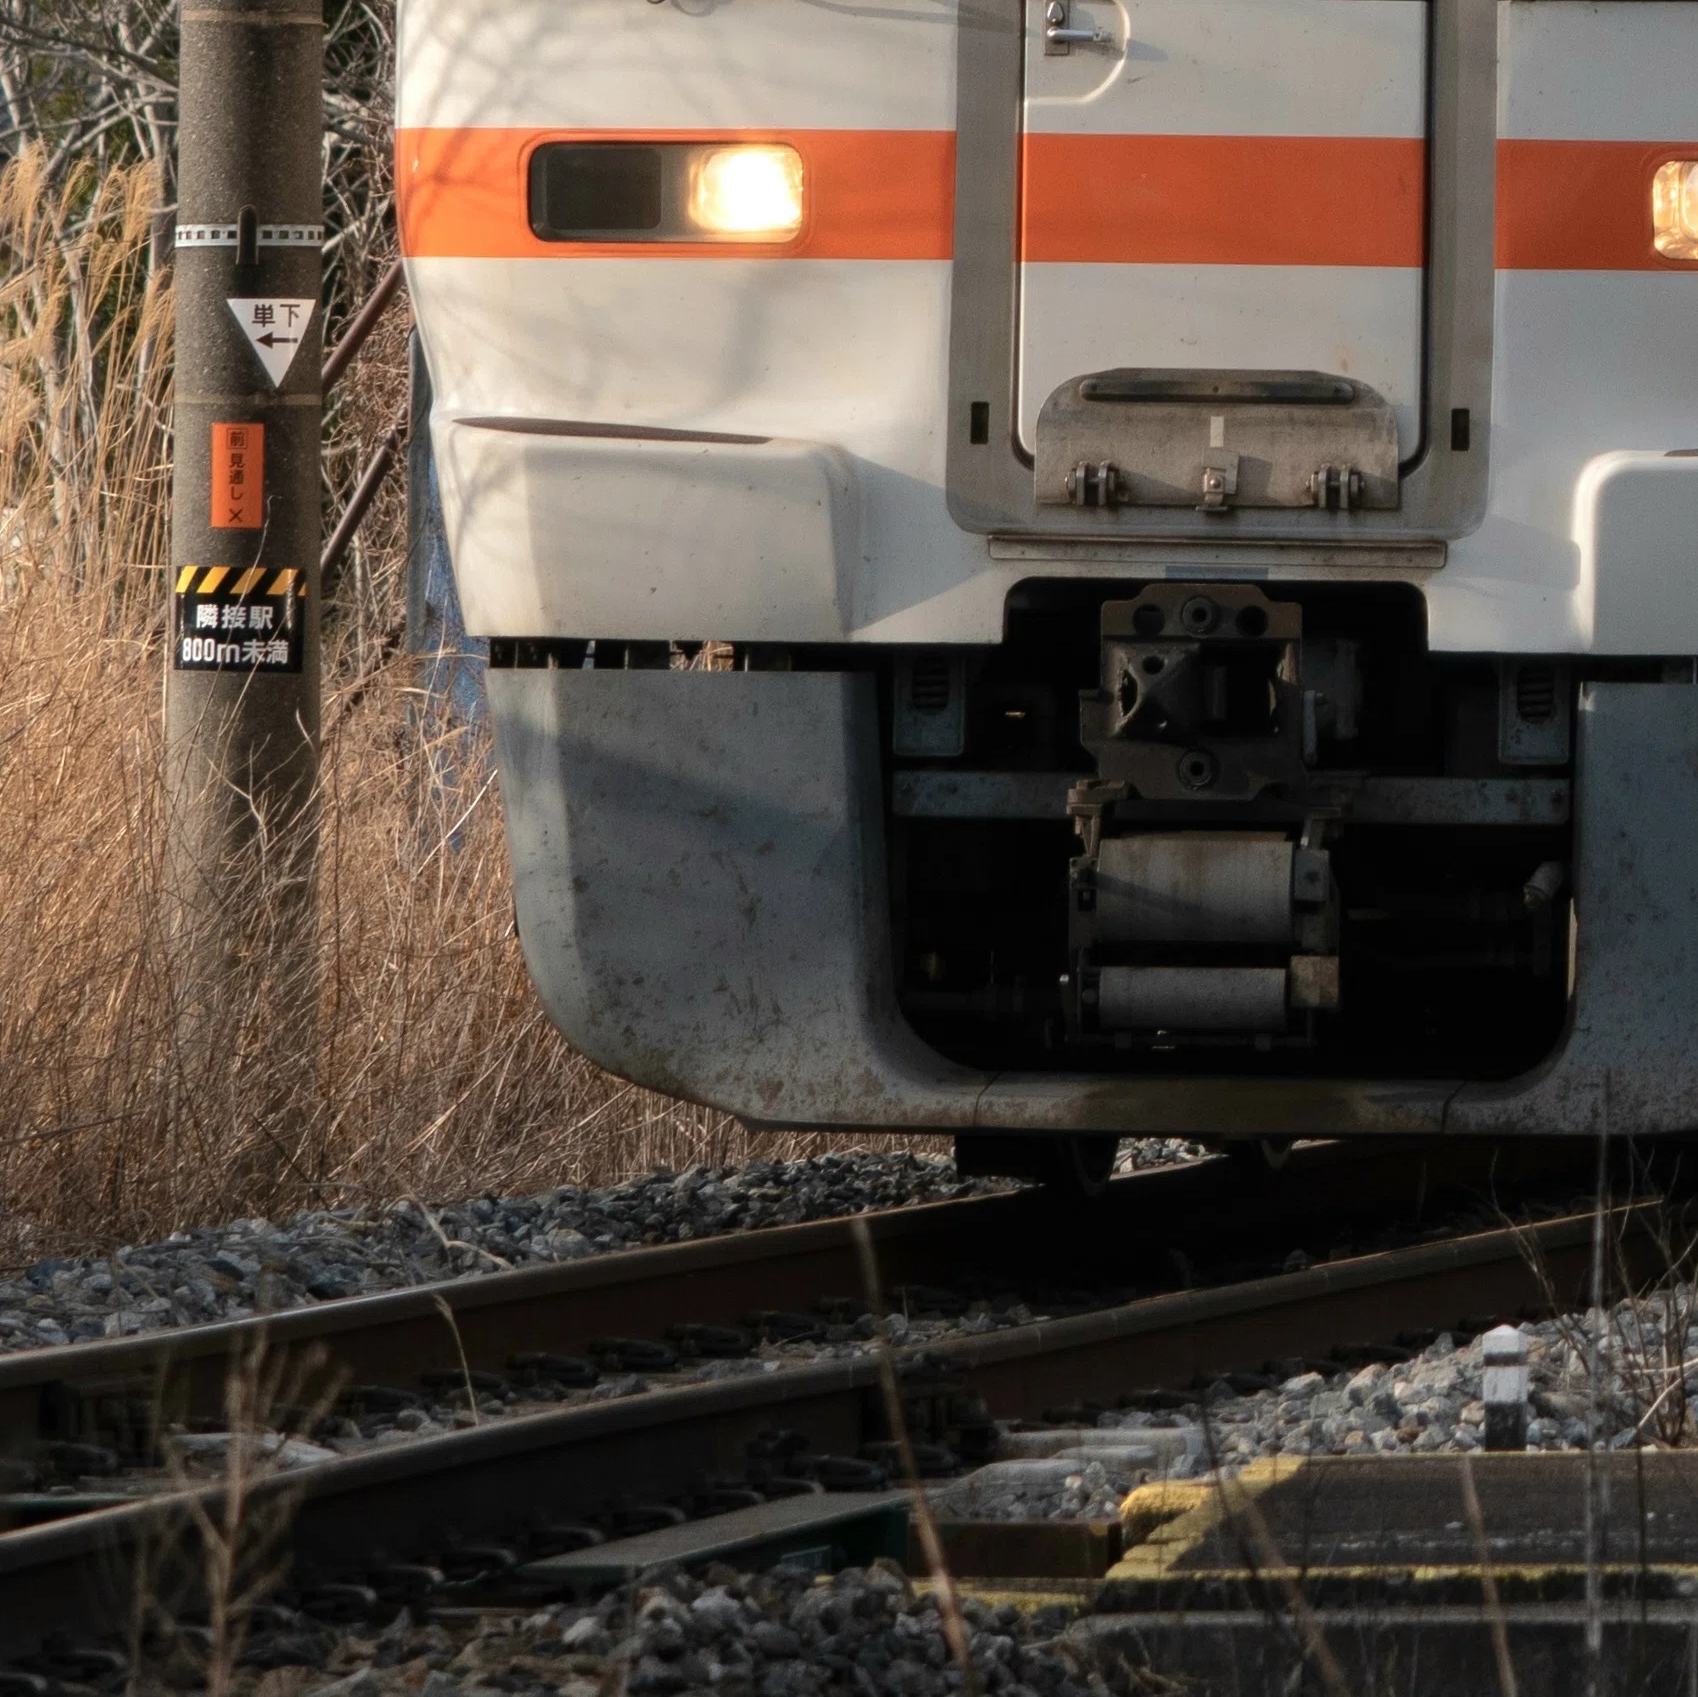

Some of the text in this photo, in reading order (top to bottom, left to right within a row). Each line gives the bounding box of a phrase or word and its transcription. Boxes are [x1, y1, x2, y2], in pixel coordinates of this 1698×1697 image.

[251, 303, 301, 328] 単下
[196, 603, 274, 630] 隣接駅
